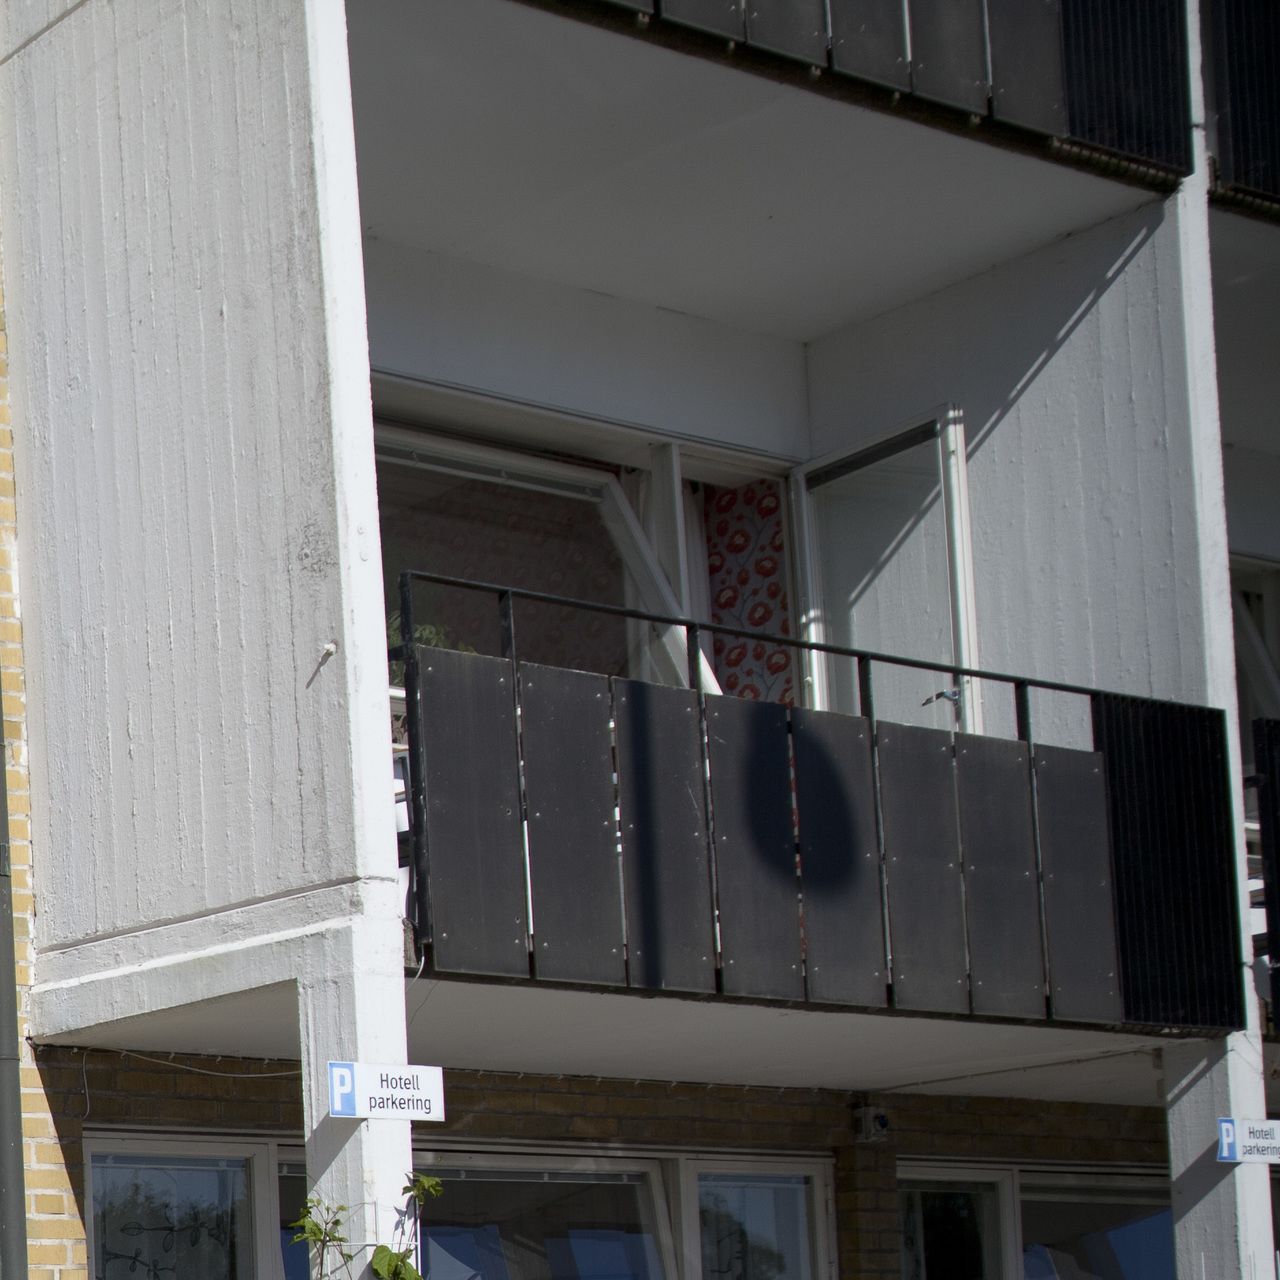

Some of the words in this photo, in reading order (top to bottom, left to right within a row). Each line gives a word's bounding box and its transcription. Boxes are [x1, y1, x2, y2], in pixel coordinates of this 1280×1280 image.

[380, 1073, 421, 1090] Hotell
[368, 1094, 432, 1115] parkering
[1248, 1126, 1276, 1140] Hotell
